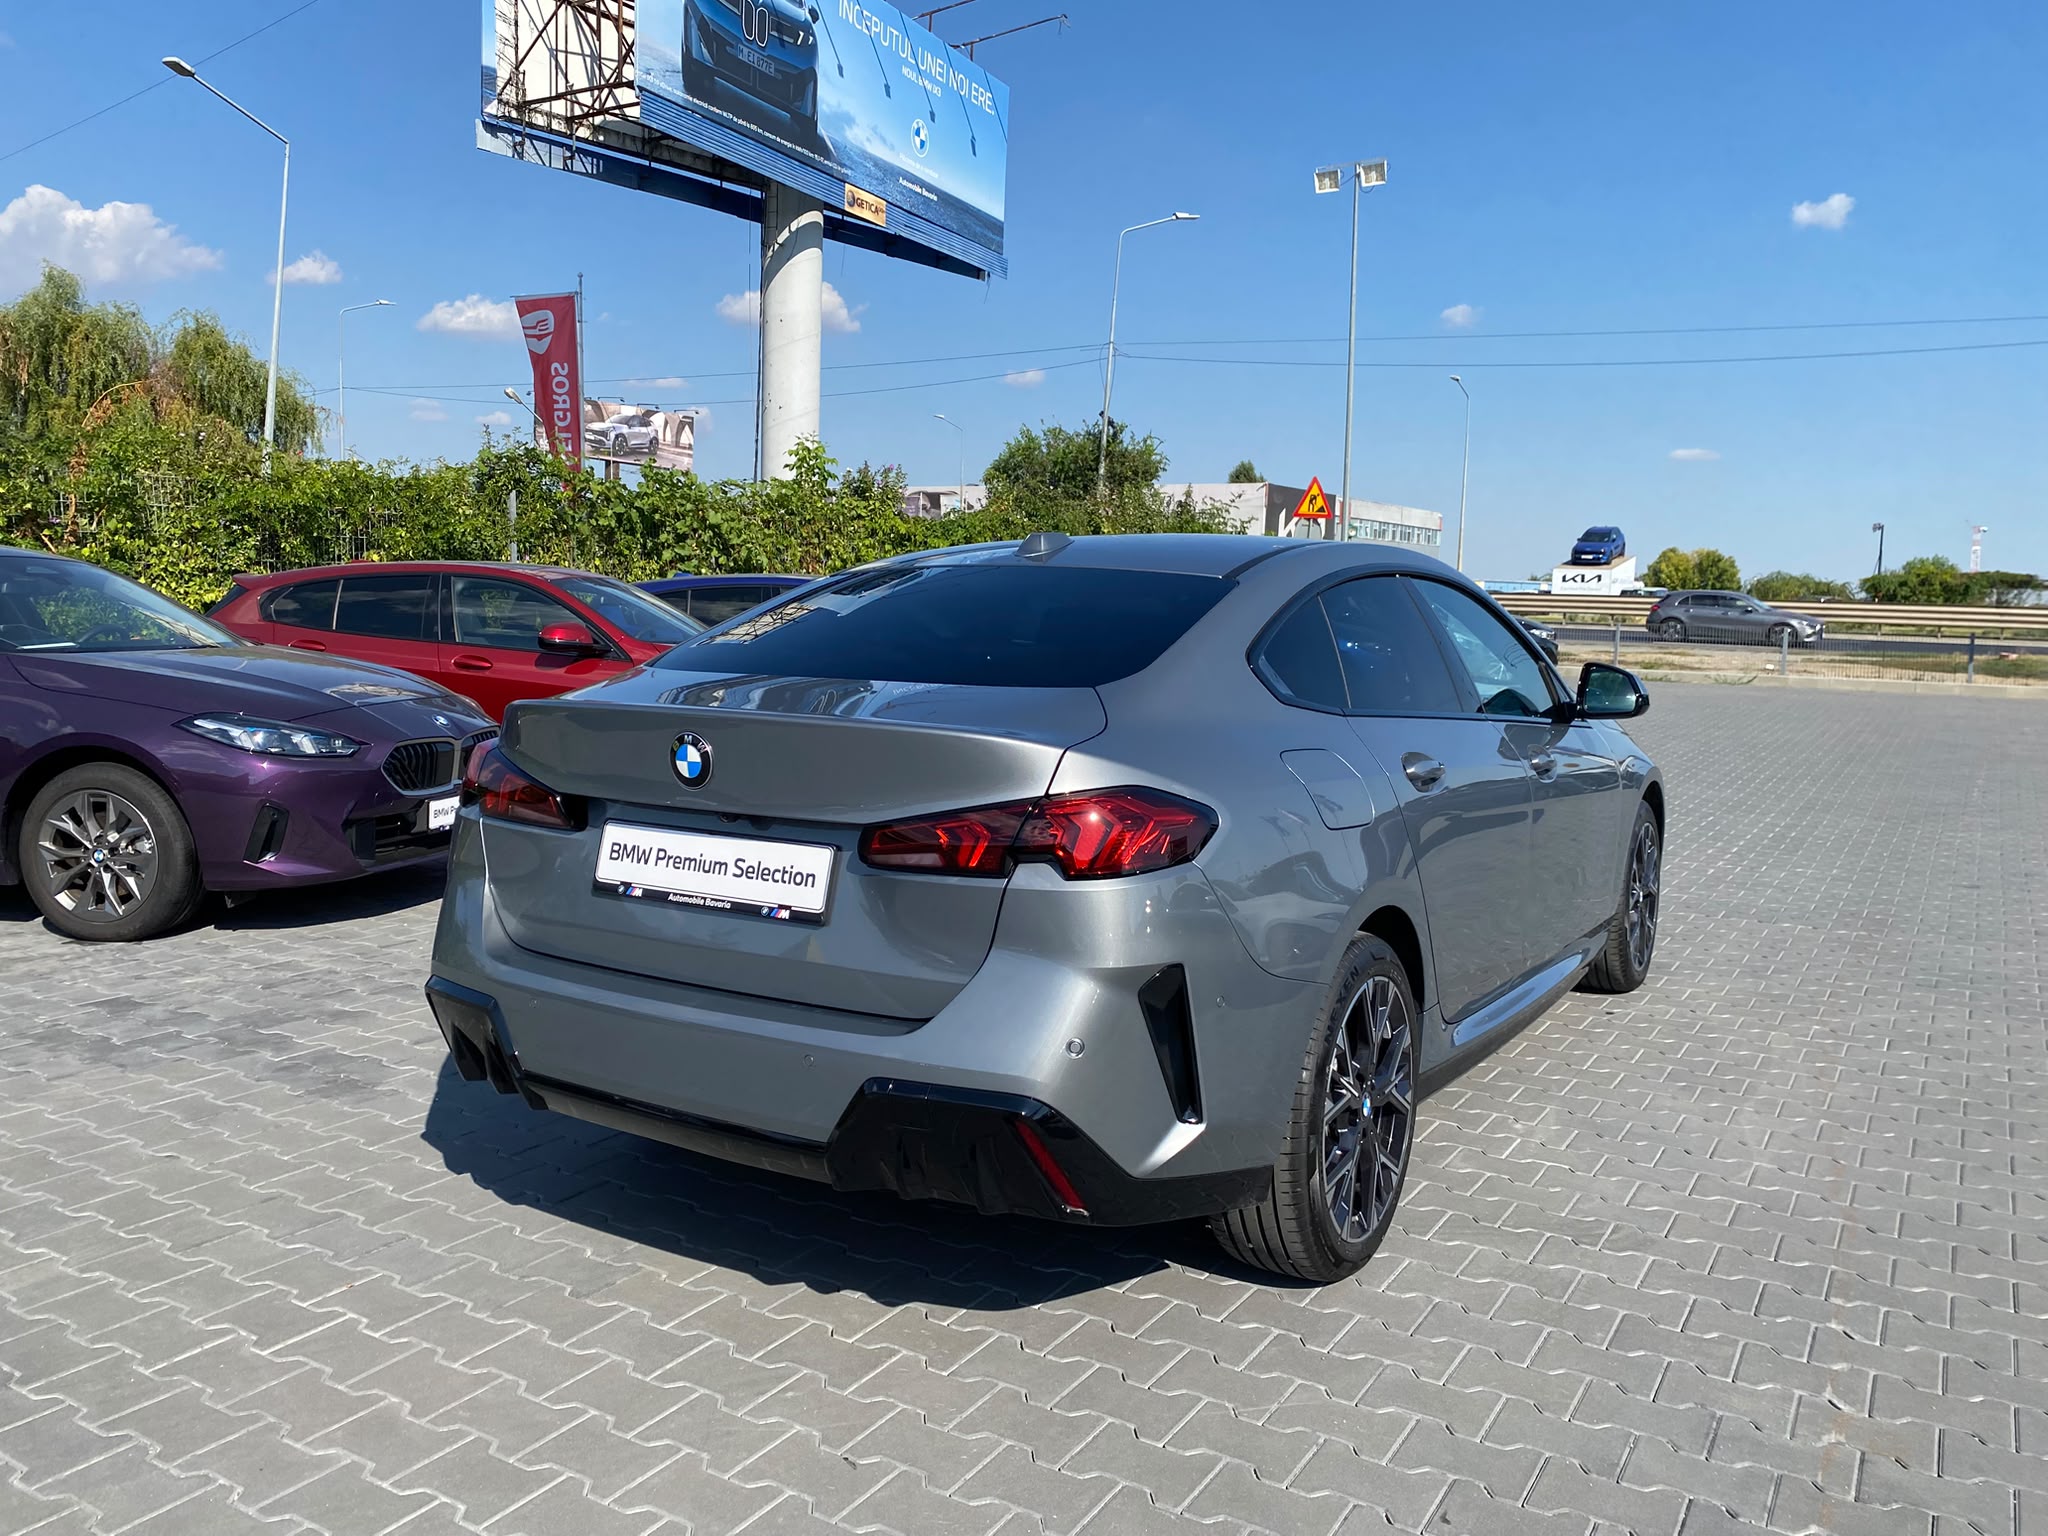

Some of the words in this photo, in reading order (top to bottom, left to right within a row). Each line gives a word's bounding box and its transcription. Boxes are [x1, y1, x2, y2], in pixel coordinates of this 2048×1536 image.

[901, 65, 917, 84] NOUL
[918, 47, 947, 83] UNEI
[948, 68, 969, 98] NOI
[971, 82, 995, 116] ERE.
[855, 197, 880, 216] GETICA
[1562, 573, 1602, 583] KIA
[433, 807, 450, 819] BMW
[609, 841, 653, 865] BMW
[655, 847, 728, 876] Premium
[732, 857, 817, 889] Selection
[667, 893, 705, 906] Automobile
[705, 897, 731, 909] Bavaria
